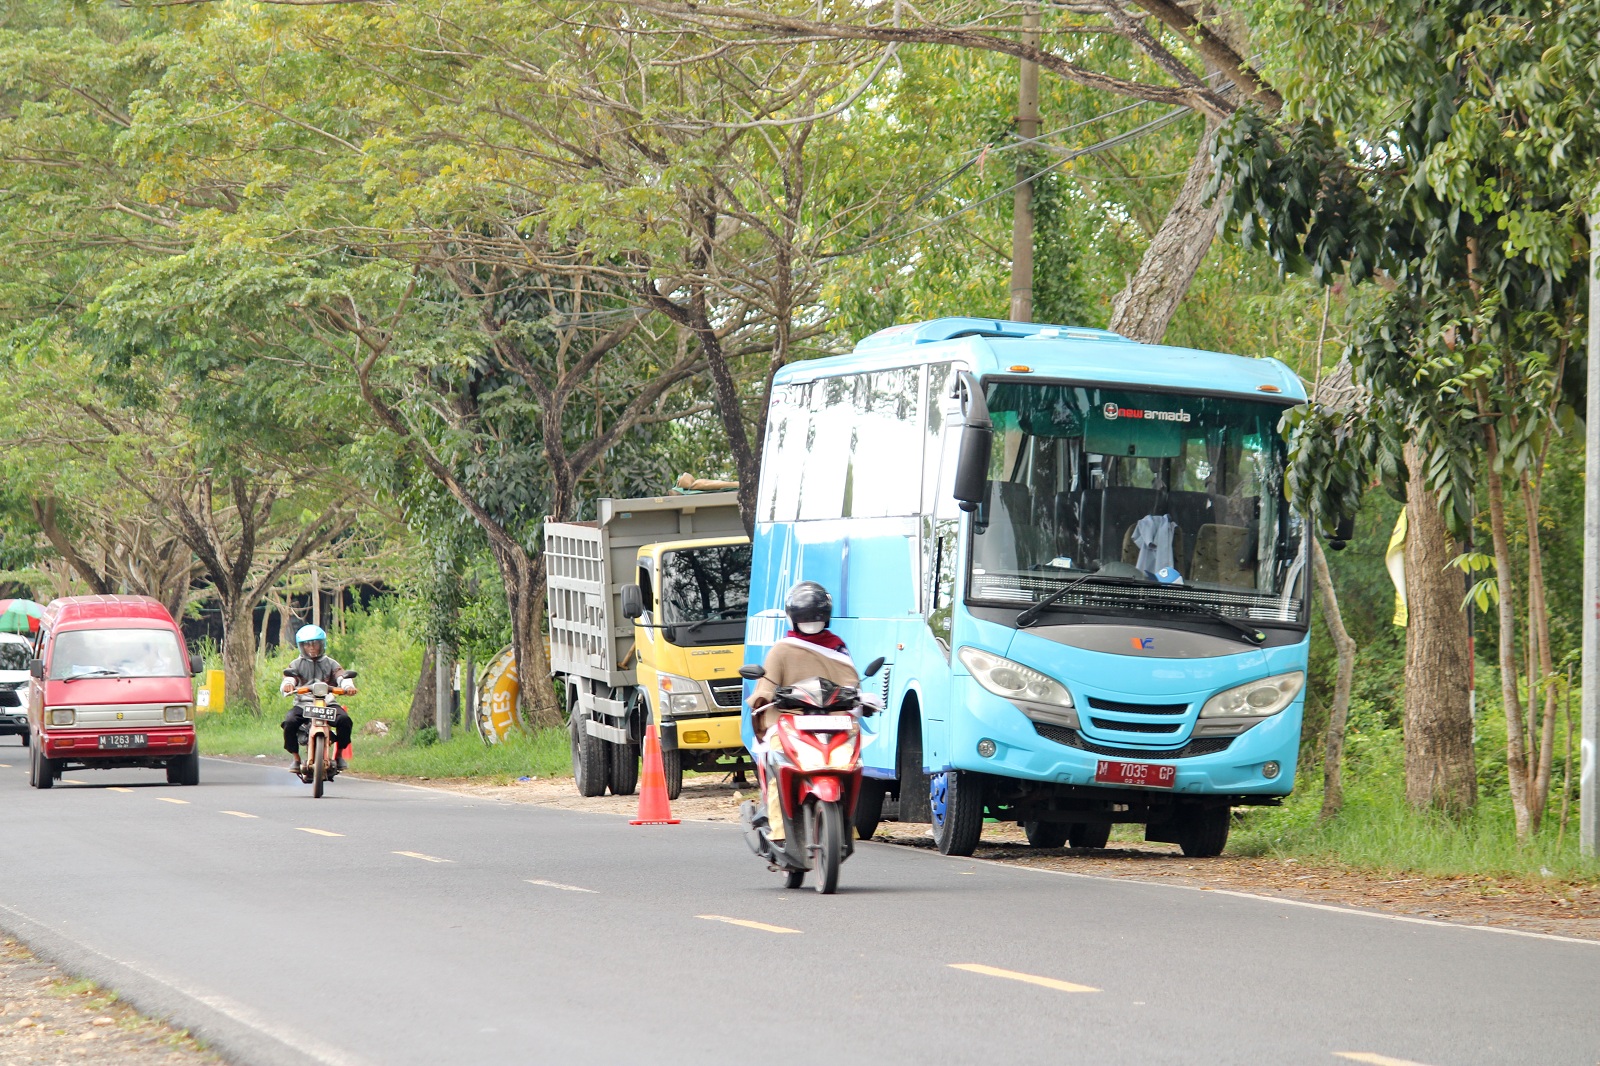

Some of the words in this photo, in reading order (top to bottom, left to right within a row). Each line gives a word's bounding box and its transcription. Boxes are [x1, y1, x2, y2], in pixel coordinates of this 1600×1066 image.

[1117, 407, 1143, 419] new
[1143, 408, 1191, 423] armada
[99, 735, 107, 745] M
[110, 735, 130, 745] 1263
[134, 734, 145, 744] NA
[1098, 761, 1109, 776] M
[1120, 763, 1149, 778] 7035
[1158, 766, 1174, 780] GP
